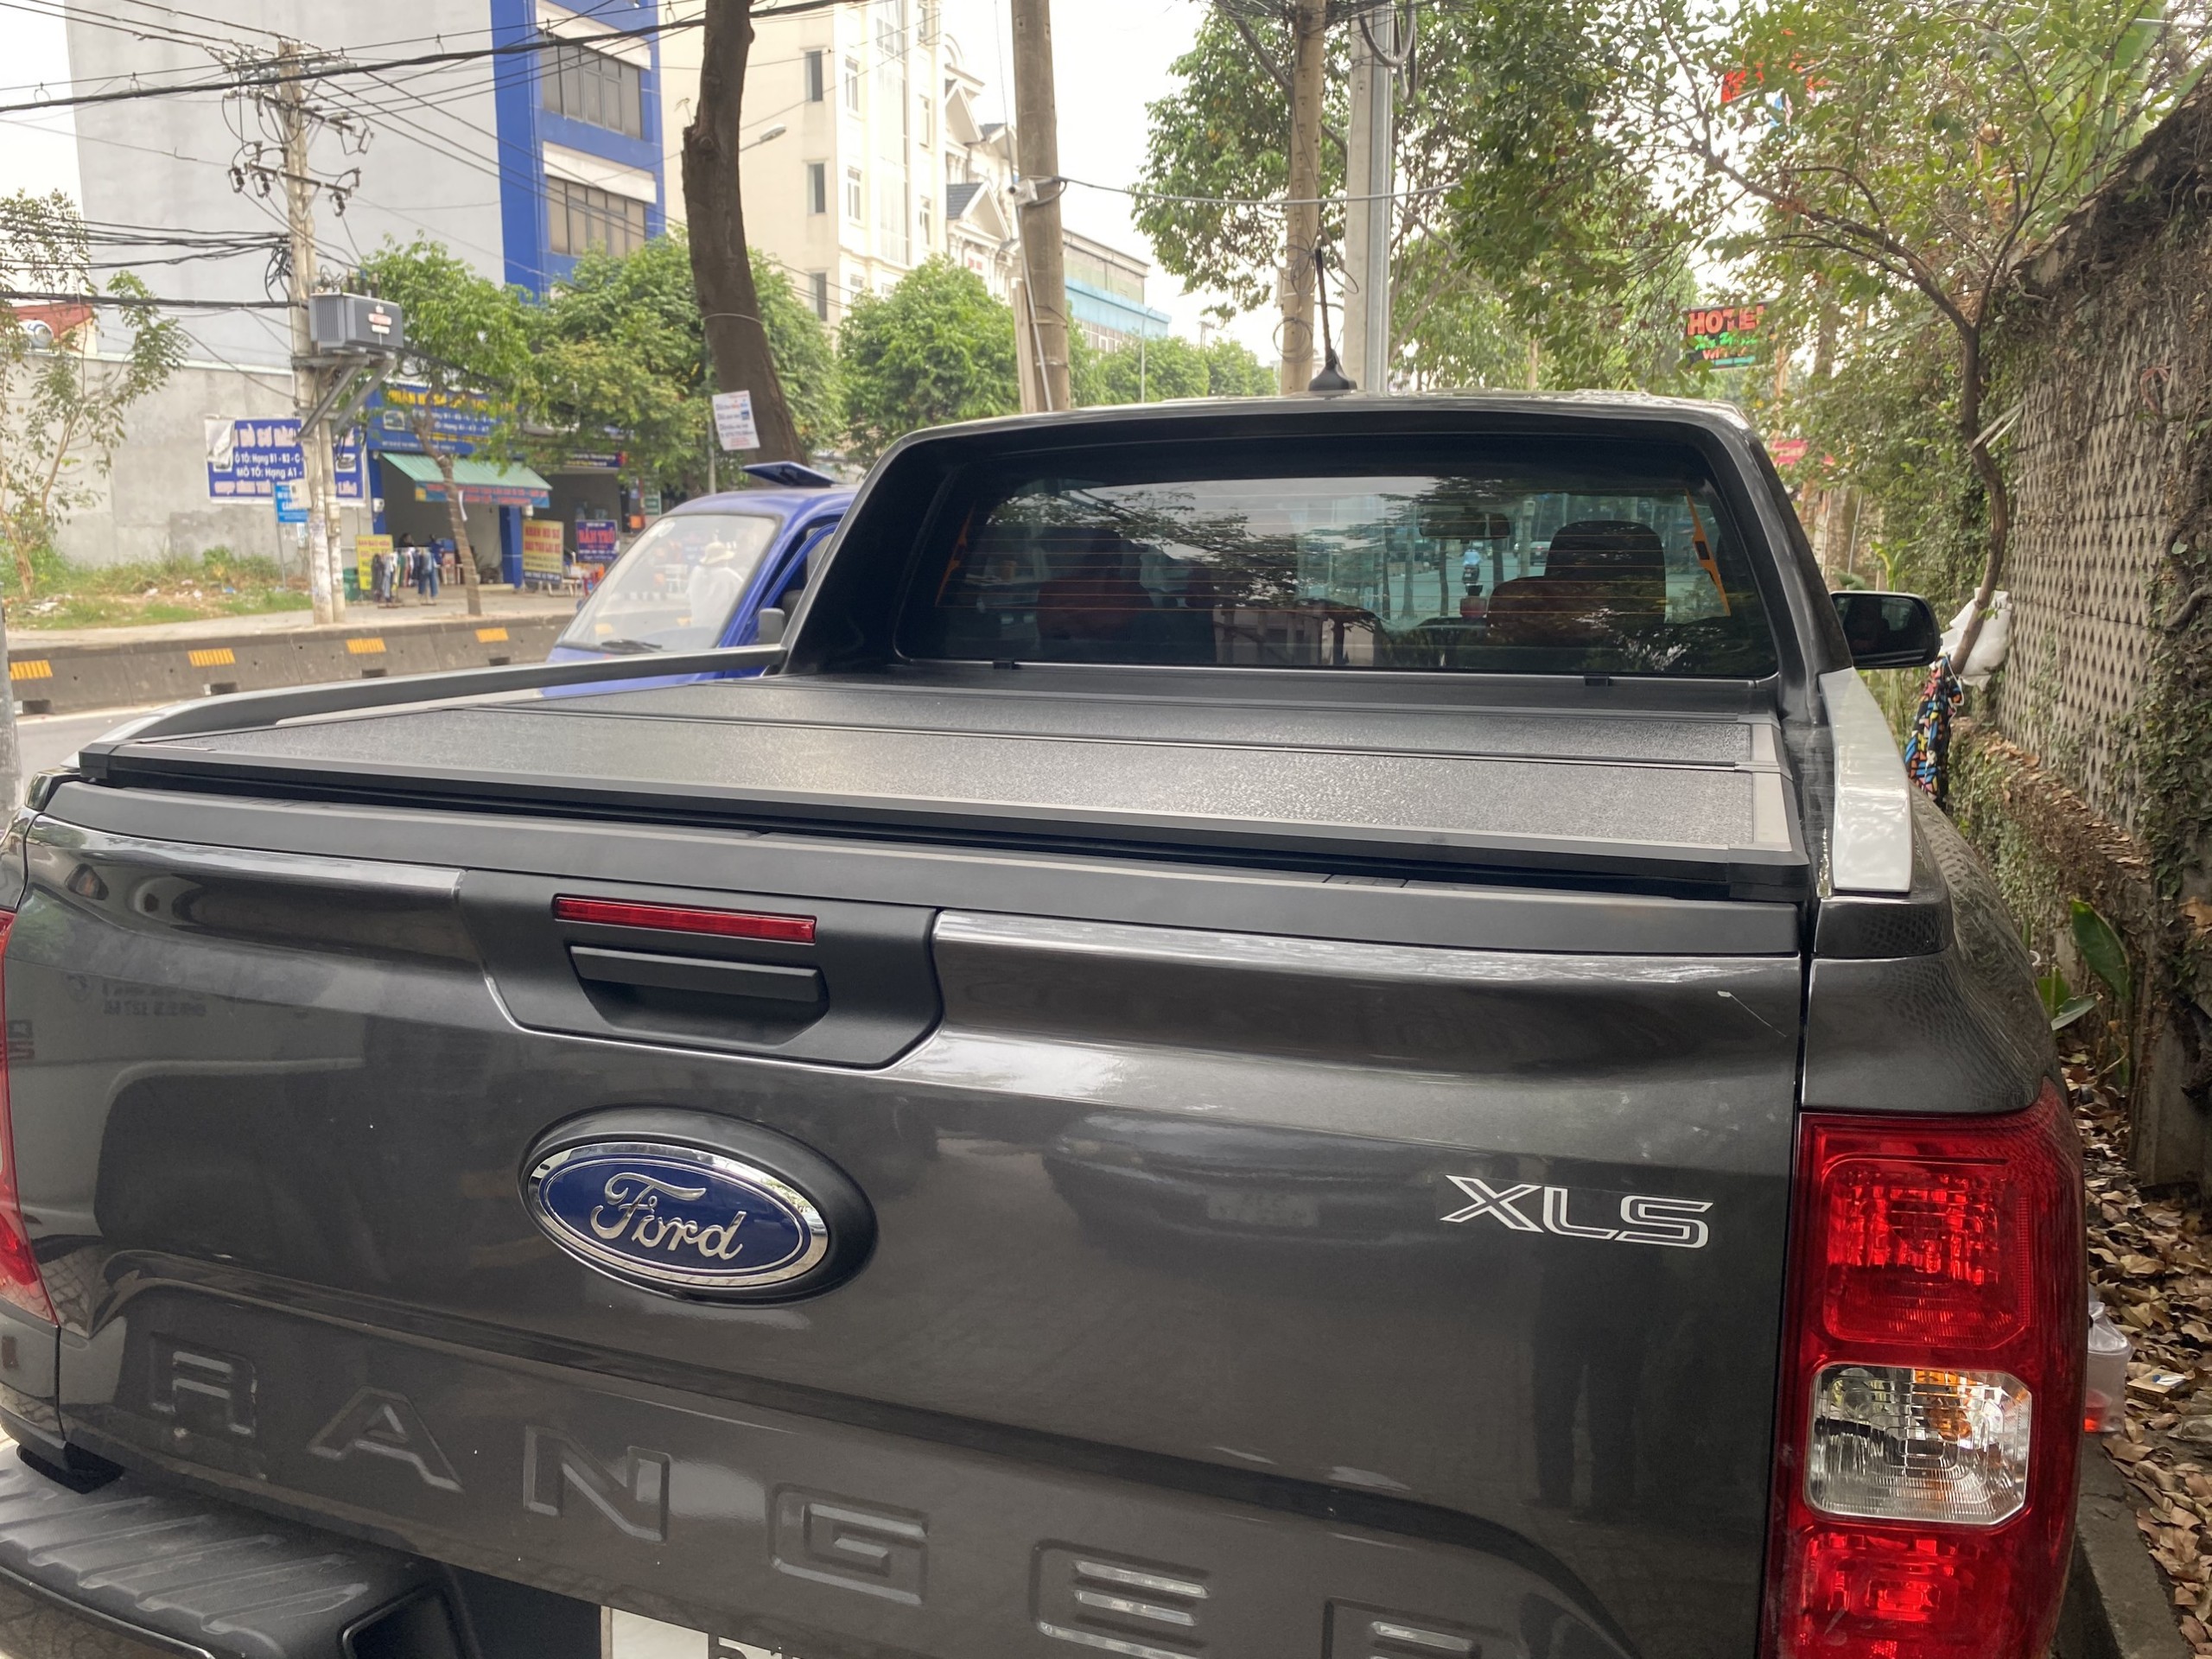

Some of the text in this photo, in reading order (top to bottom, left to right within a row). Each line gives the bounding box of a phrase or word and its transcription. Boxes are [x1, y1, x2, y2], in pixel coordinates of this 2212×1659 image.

[237, 466, 251, 477] MÔ
[265, 468, 286, 480] Hạng
[288, 467, 297, 477] A1
[590, 1172, 744, 1260] Ford
[1440, 1174, 1714, 1249] XLS
